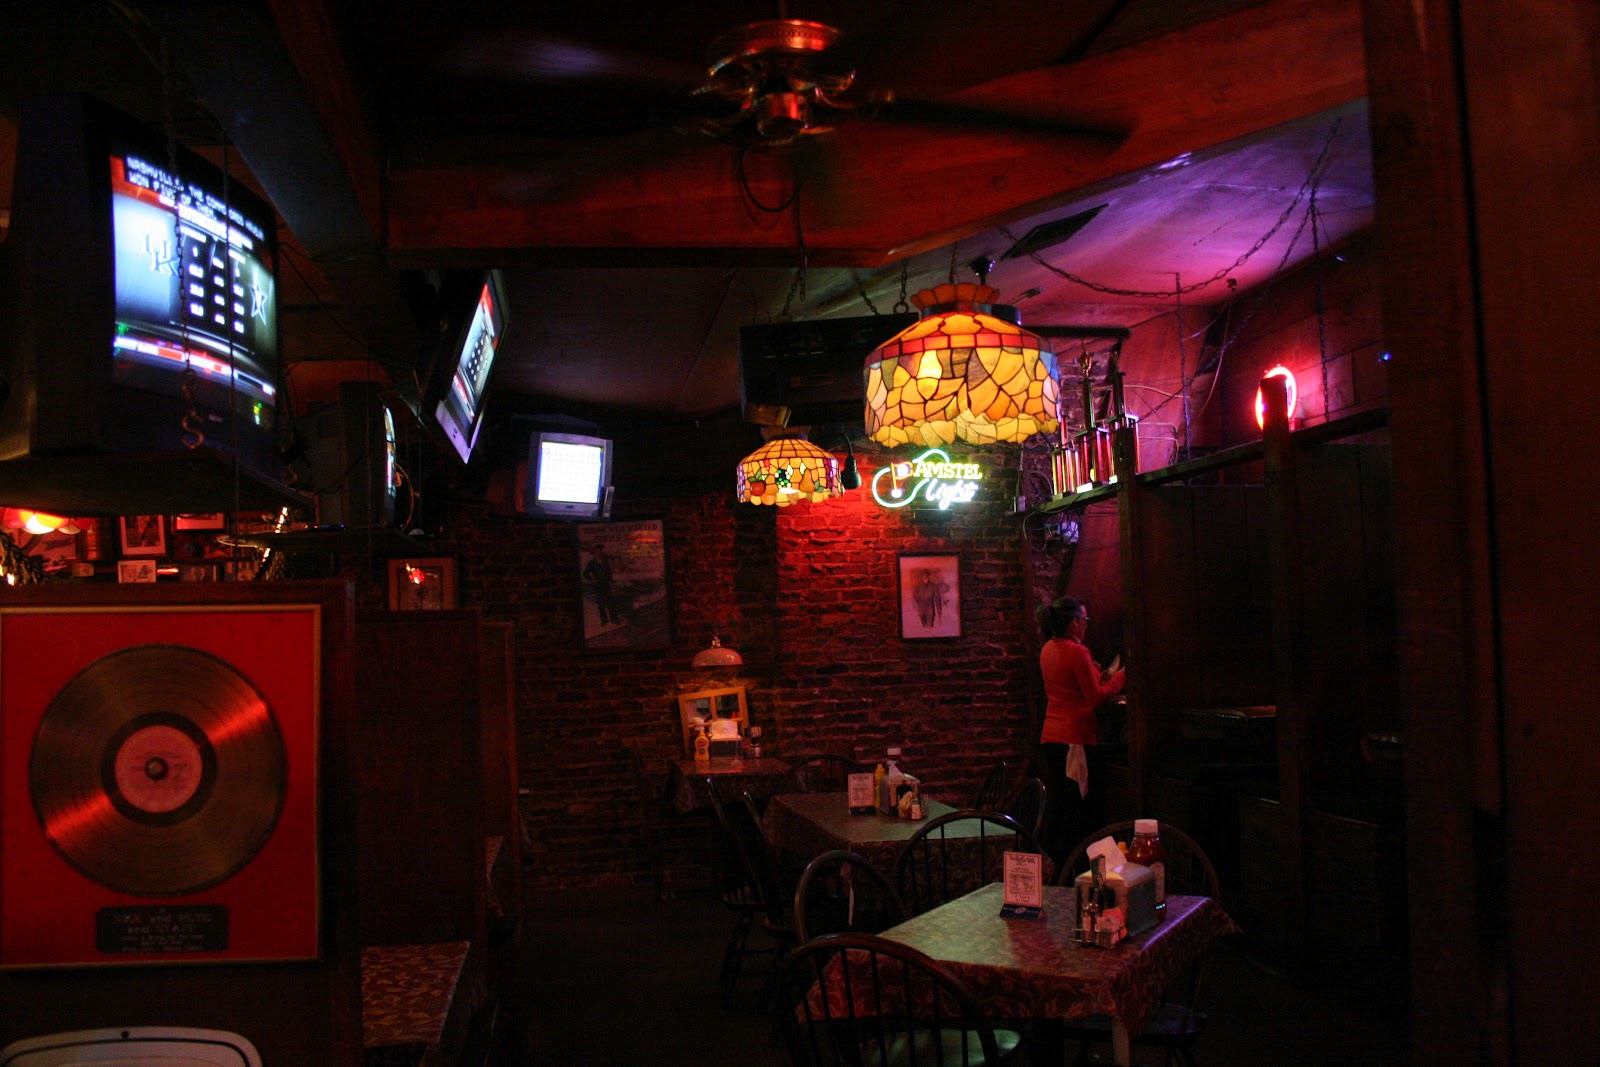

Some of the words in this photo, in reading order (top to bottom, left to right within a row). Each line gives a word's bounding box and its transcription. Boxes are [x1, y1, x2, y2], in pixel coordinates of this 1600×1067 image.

[128, 171, 150, 188] WON
[181, 194, 192, 206] OF
[189, 185, 204, 203] THE
[912, 460, 983, 480] AMSTEL
